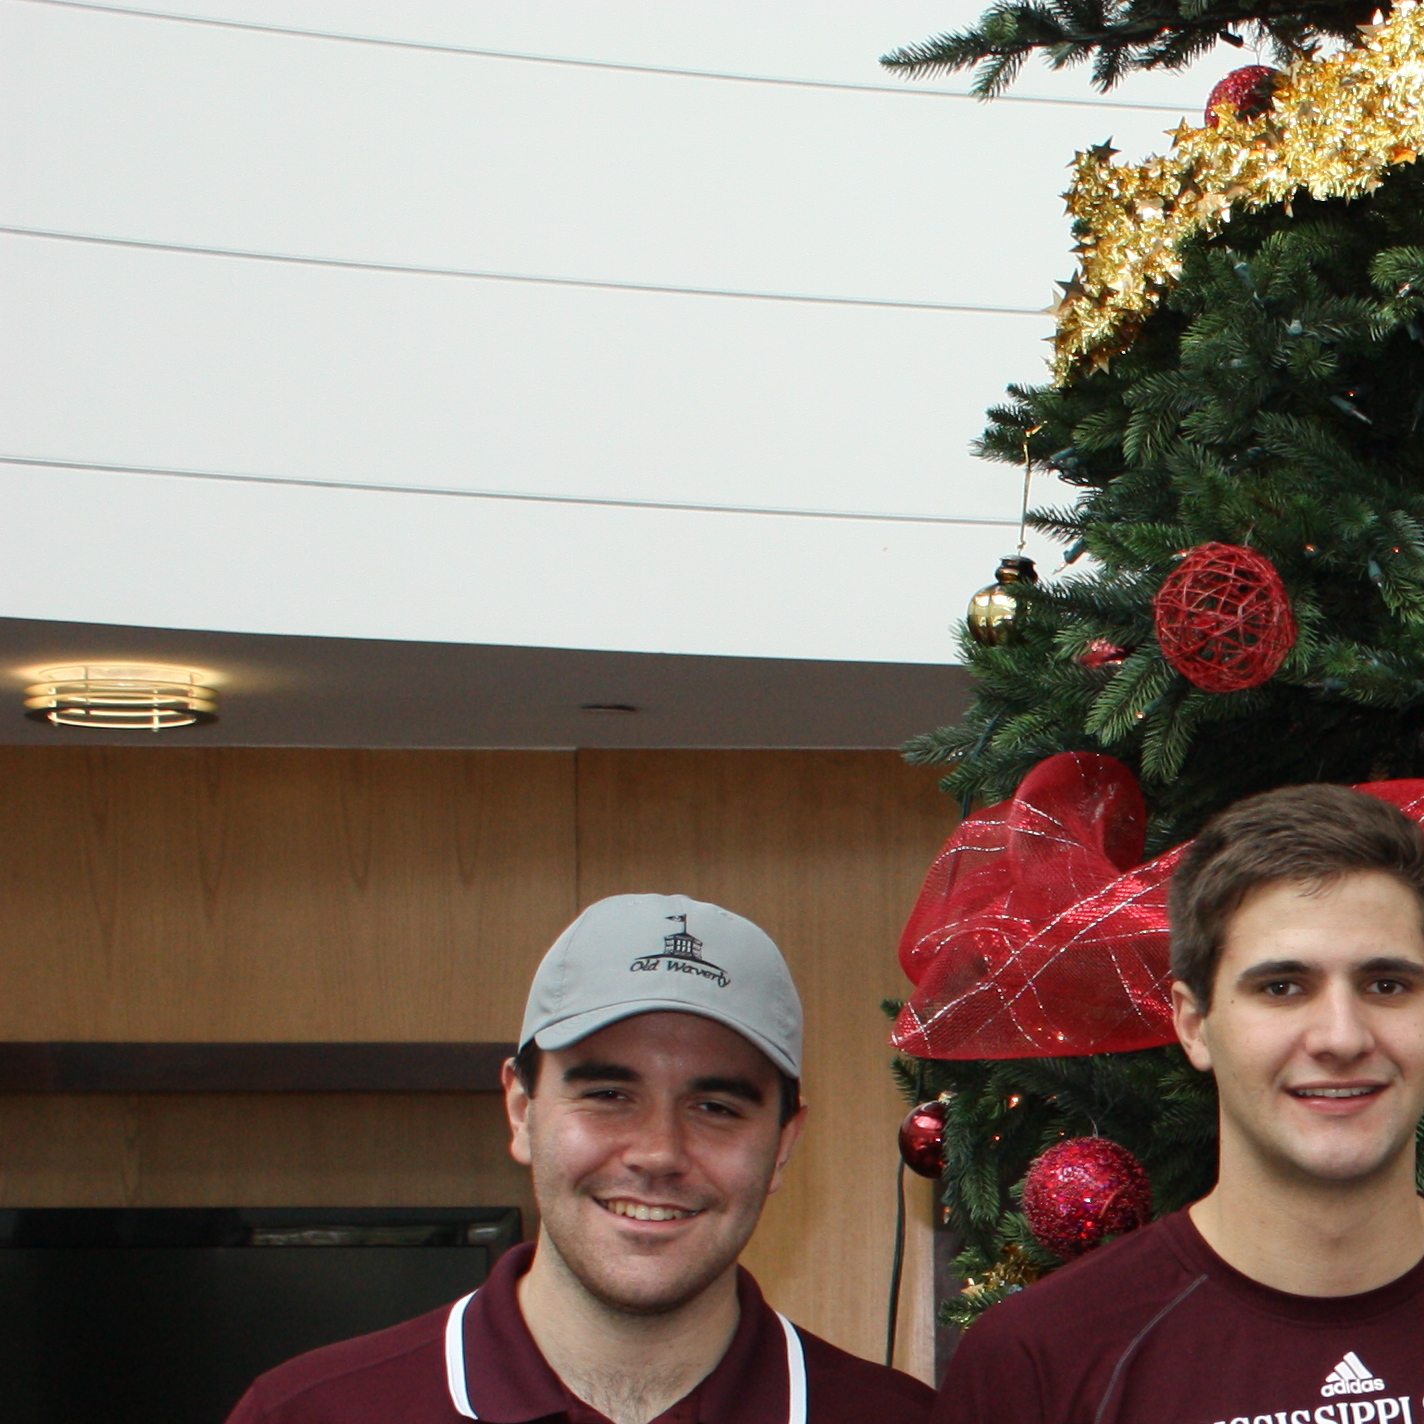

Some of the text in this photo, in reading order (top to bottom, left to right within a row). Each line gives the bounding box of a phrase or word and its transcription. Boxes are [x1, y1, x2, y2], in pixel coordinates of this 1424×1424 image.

[630, 959, 731, 987] Old Waverly
[1320, 1376, 1386, 1398] adidas
